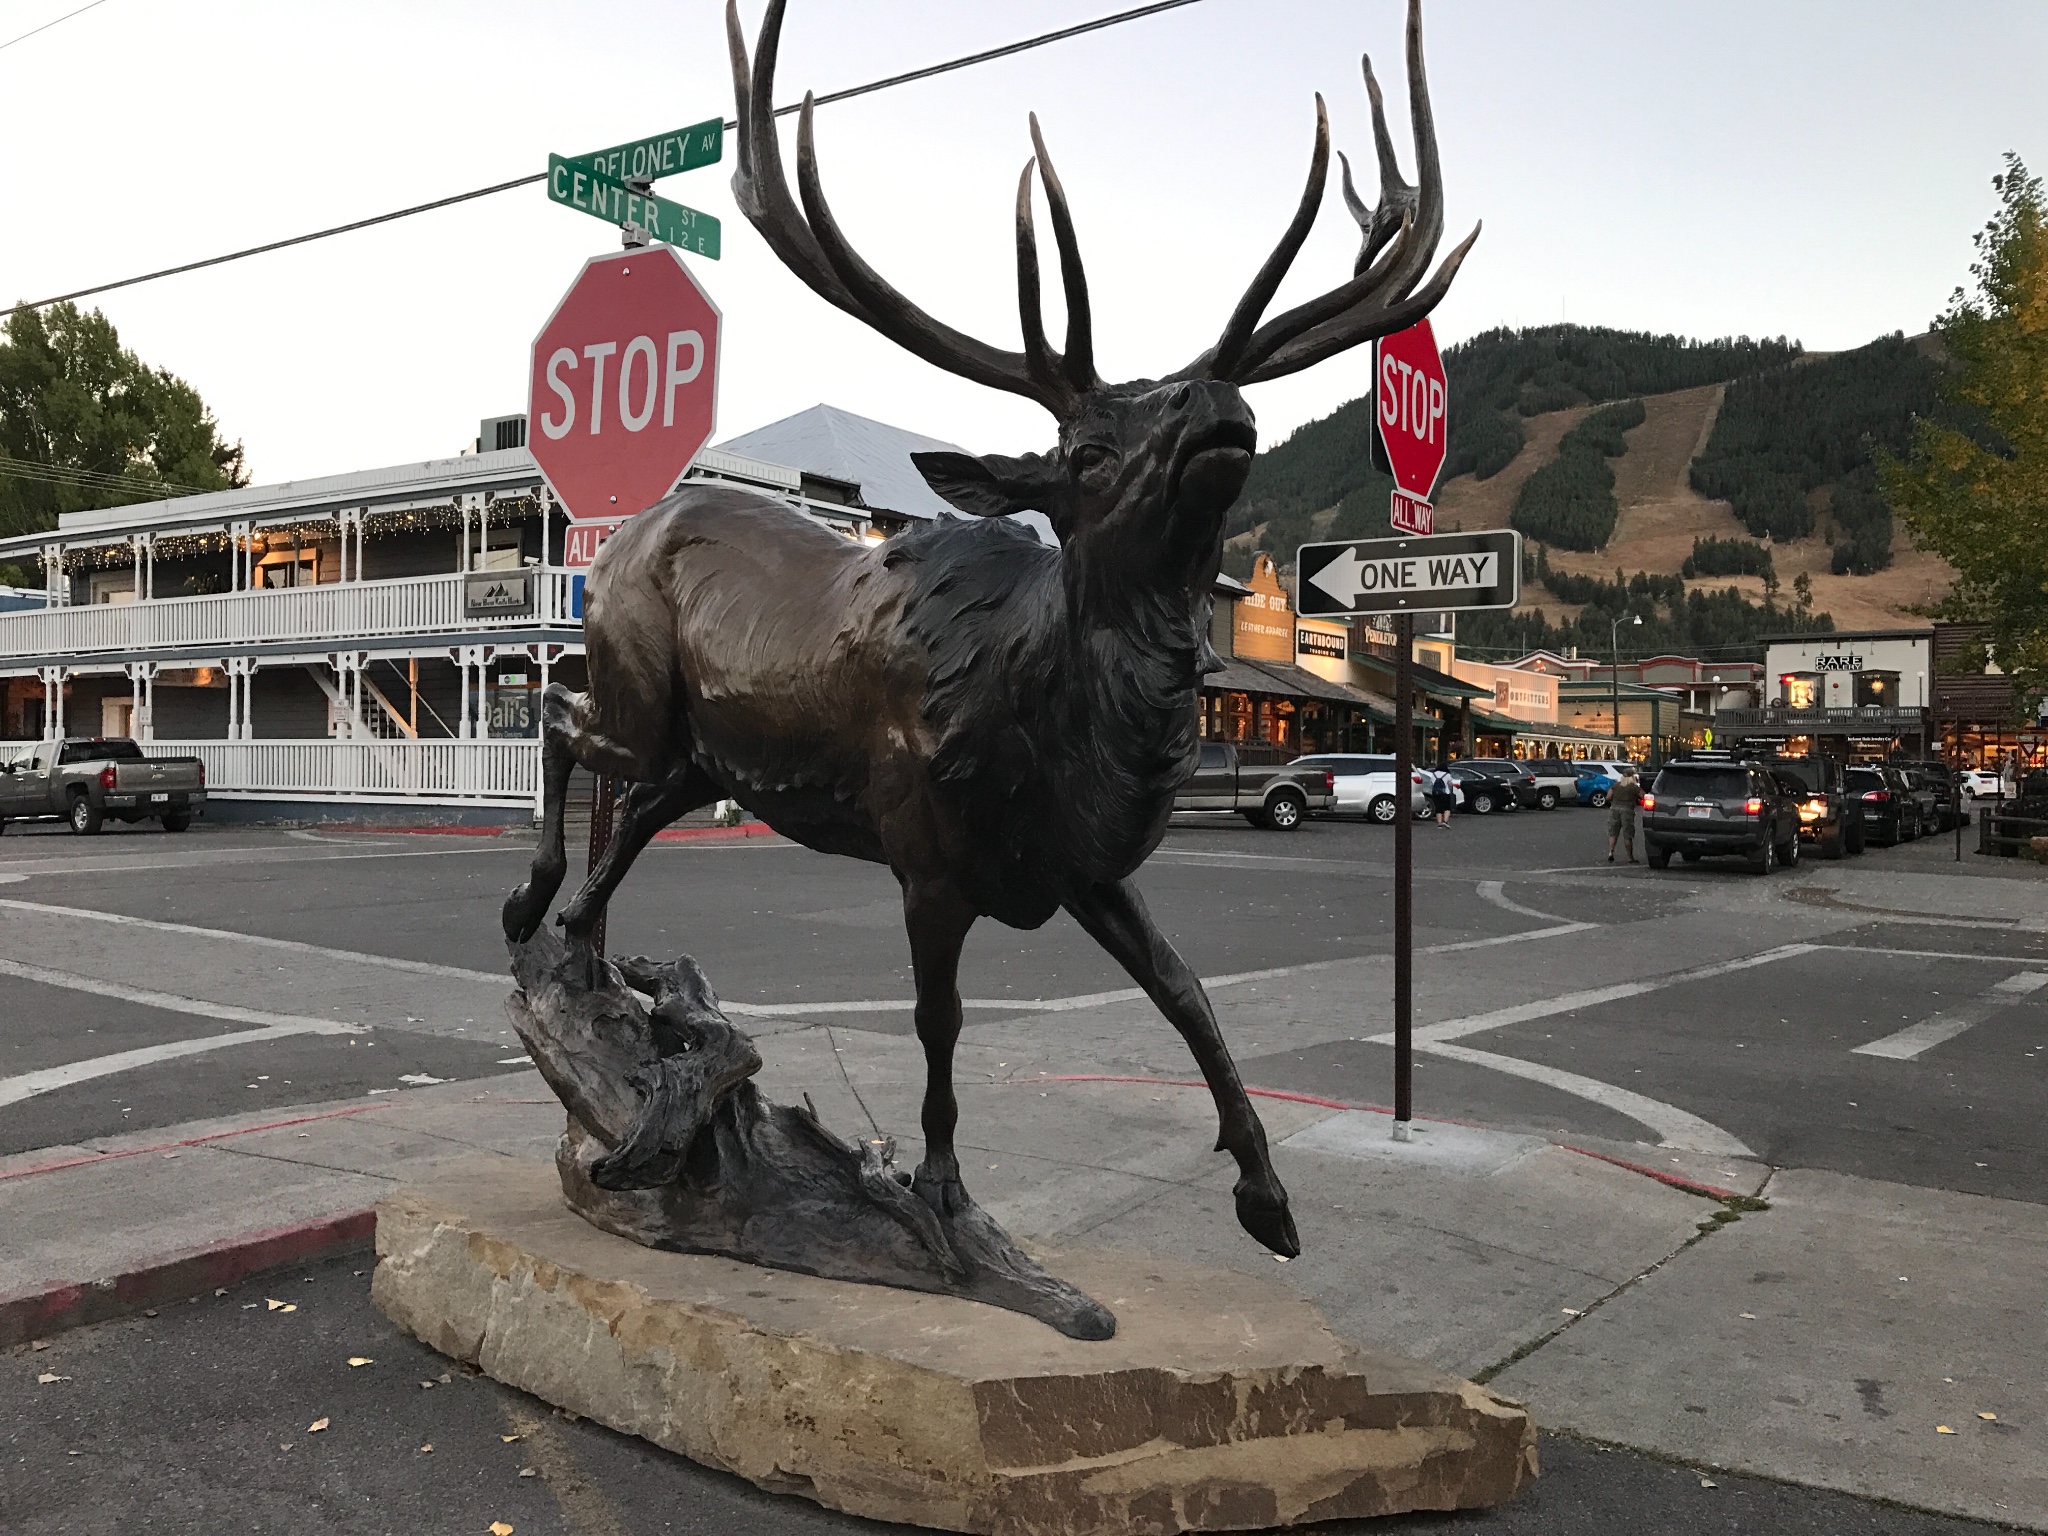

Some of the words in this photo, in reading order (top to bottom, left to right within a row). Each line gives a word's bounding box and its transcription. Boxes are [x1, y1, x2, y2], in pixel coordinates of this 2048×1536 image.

[593, 133, 691, 181] DELONEY
[701, 132, 716, 153] AV
[553, 164, 660, 235] CENTER
[681, 209, 697, 228] ST
[540, 329, 705, 440] STOP
[1381, 353, 1444, 445] STOP
[1393, 497, 1410, 528] ALL
[1414, 503, 1432, 534] WAY
[1360, 561, 1417, 590] ONE
[1428, 556, 1489, 587] WAY
[1244, 593, 1266, 609] HIDE
[1269, 595, 1287, 612] OUT
[1300, 631, 1344, 650] EARTHBOUND
[1816, 656, 1862, 666] RARE
[1510, 691, 1549, 705] OUTFITTERS
